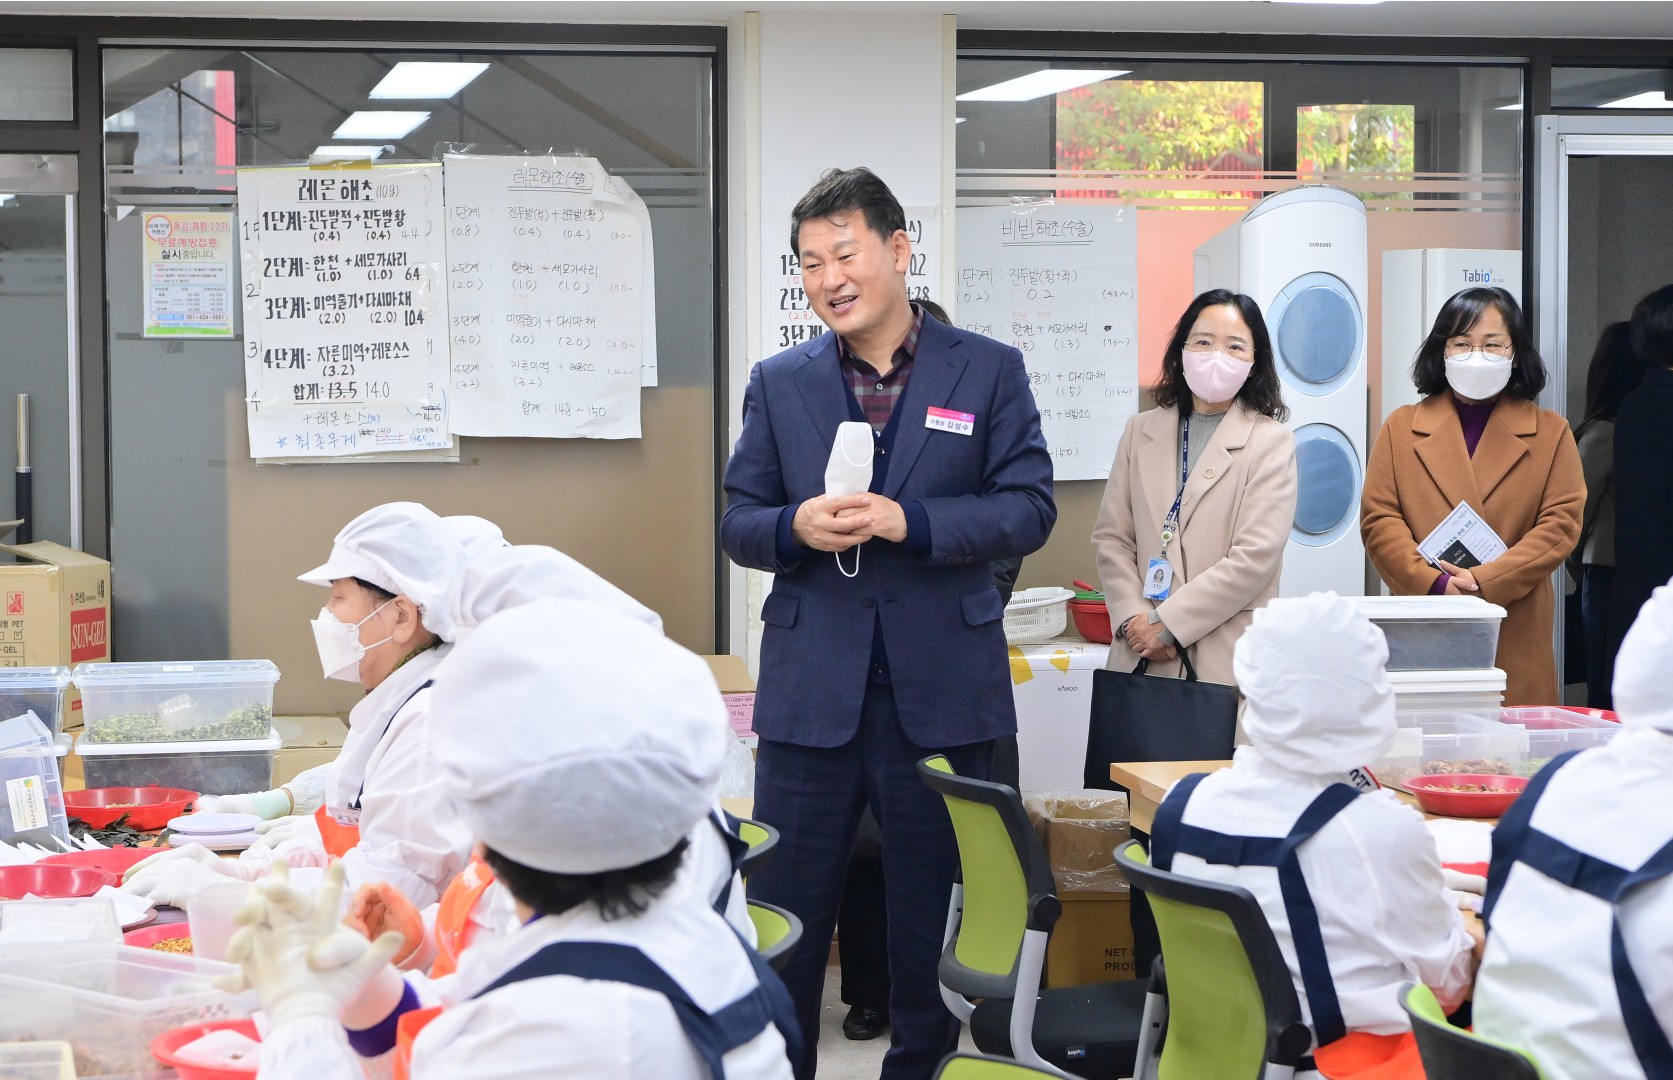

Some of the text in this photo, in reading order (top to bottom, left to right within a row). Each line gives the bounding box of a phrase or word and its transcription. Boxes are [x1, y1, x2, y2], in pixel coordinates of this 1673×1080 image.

[313, 231, 341, 242] (0.4)
[366, 230, 391, 241] (0.4)
[313, 254, 339, 272] 한천
[316, 271, 342, 282] (1.0)
[367, 269, 393, 281] (1.0)
[1462, 269, 1490, 282] Tabio
[319, 312, 346, 325] (2.0)
[370, 311, 397, 324] (2.0)
[322, 364, 355, 377] (3.2)
[947, 420, 969, 431] 김성수
[12, 620, 24, 628] PET
[71, 620, 106, 650] SUN-GEL
[1104, 948, 1127, 957] NET
